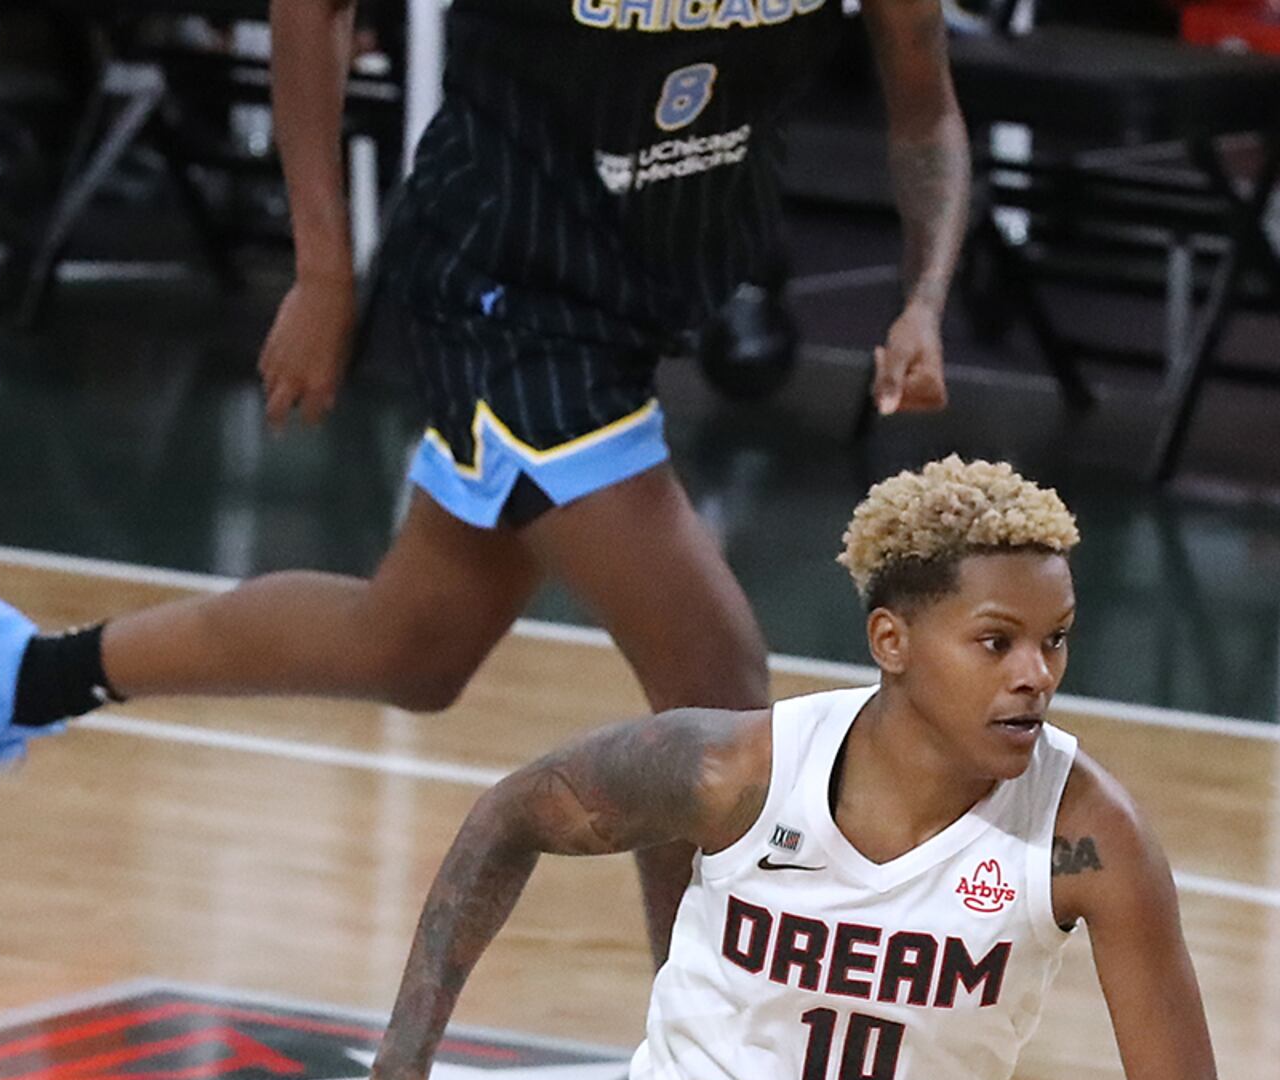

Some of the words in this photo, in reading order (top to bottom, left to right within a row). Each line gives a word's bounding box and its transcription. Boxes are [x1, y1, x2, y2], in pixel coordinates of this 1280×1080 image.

[655, 62, 718, 131] 8
[955, 876, 1016, 905] Arby's
[721, 894, 1013, 1010] DREAM
